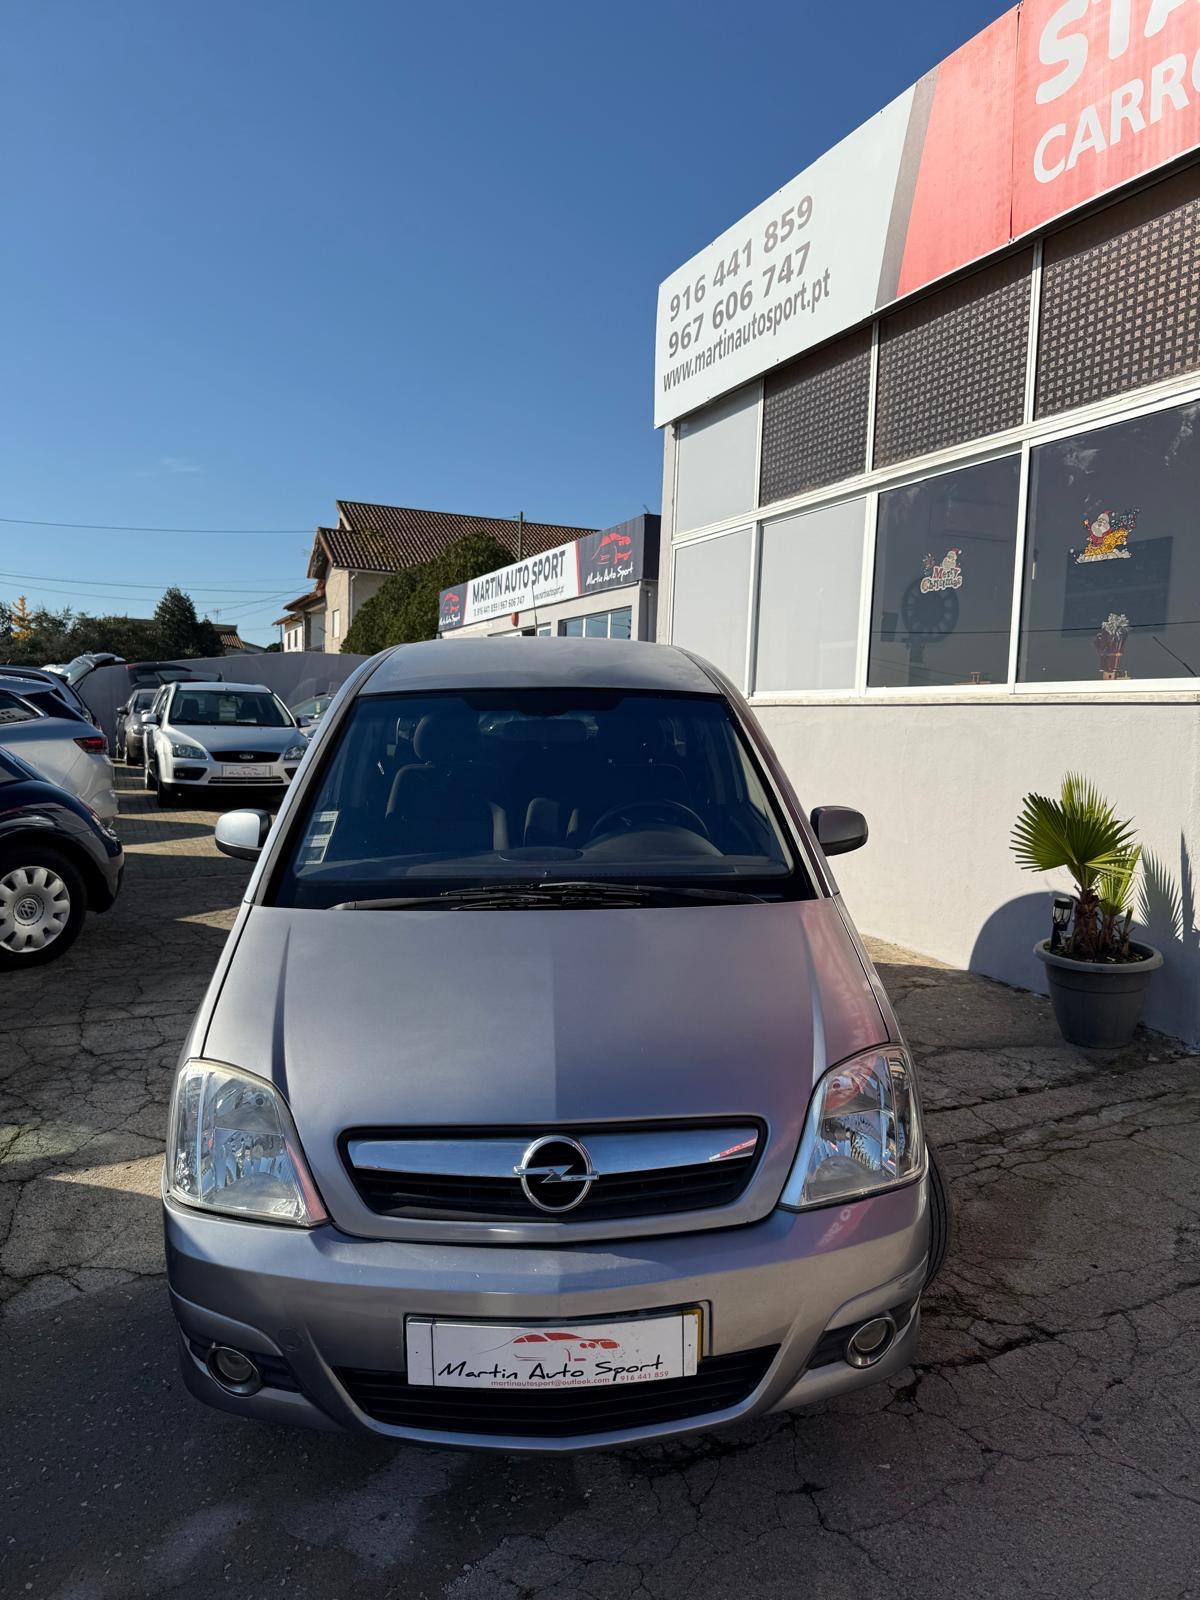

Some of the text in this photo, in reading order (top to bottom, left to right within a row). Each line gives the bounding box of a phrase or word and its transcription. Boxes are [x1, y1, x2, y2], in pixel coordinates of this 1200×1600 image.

[1033, 48, 1200, 184] CARR
[669, 241, 811, 358] 967 606 747
[670, 195, 813, 322] 916 441 859
[663, 267, 831, 392] www.martinautosport.pt
[473, 550, 566, 605] MARTIN AUTO SPORT
[617, 561, 634, 582] Sport
[438, 1354, 663, 1381] Martin Auto Sport
[491, 1377, 610, 1387] martinautosport@outlook.com
